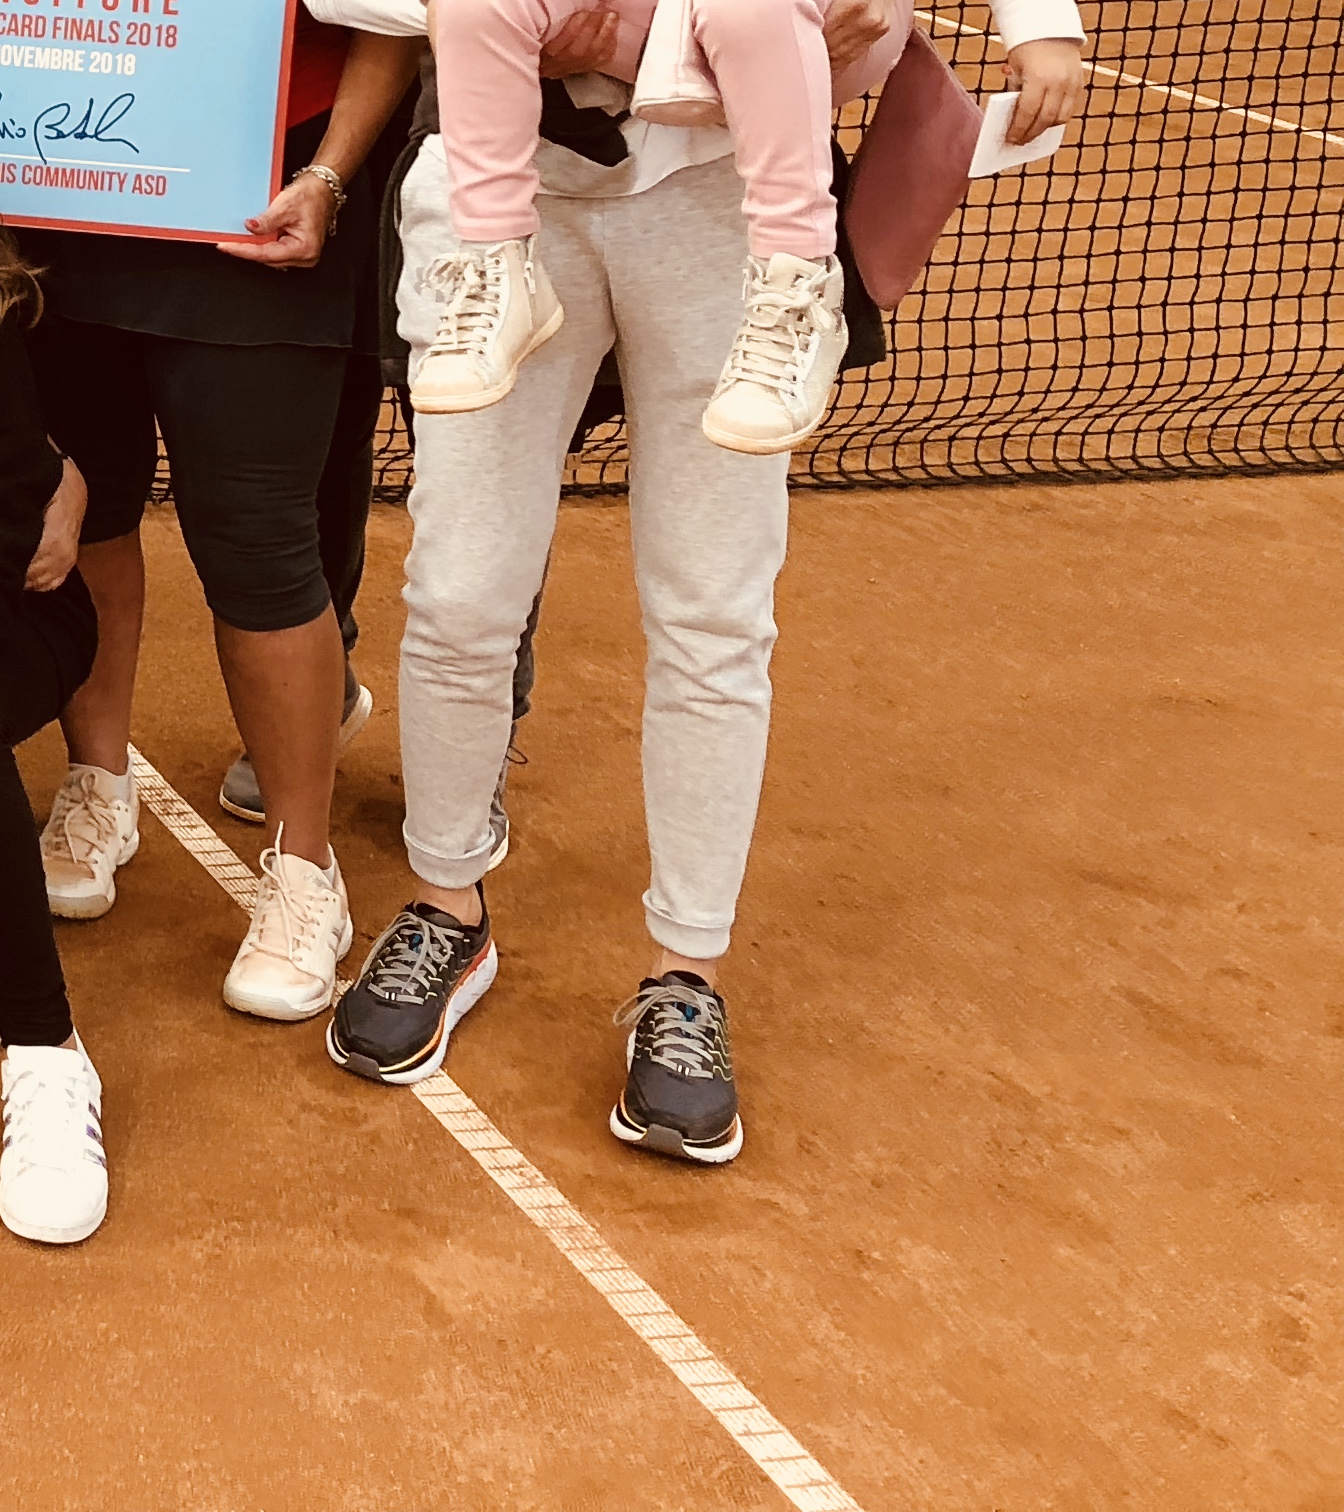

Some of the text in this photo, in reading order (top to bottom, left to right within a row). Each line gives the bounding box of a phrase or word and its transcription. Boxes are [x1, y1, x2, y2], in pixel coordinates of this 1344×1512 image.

[52, 18, 120, 44] FINALS
[126, 23, 178, 47] 2018
[89, 52, 136, 75] 2018
[21, 164, 128, 193] COMMUNITY
[131, 174, 167, 196] ASD
